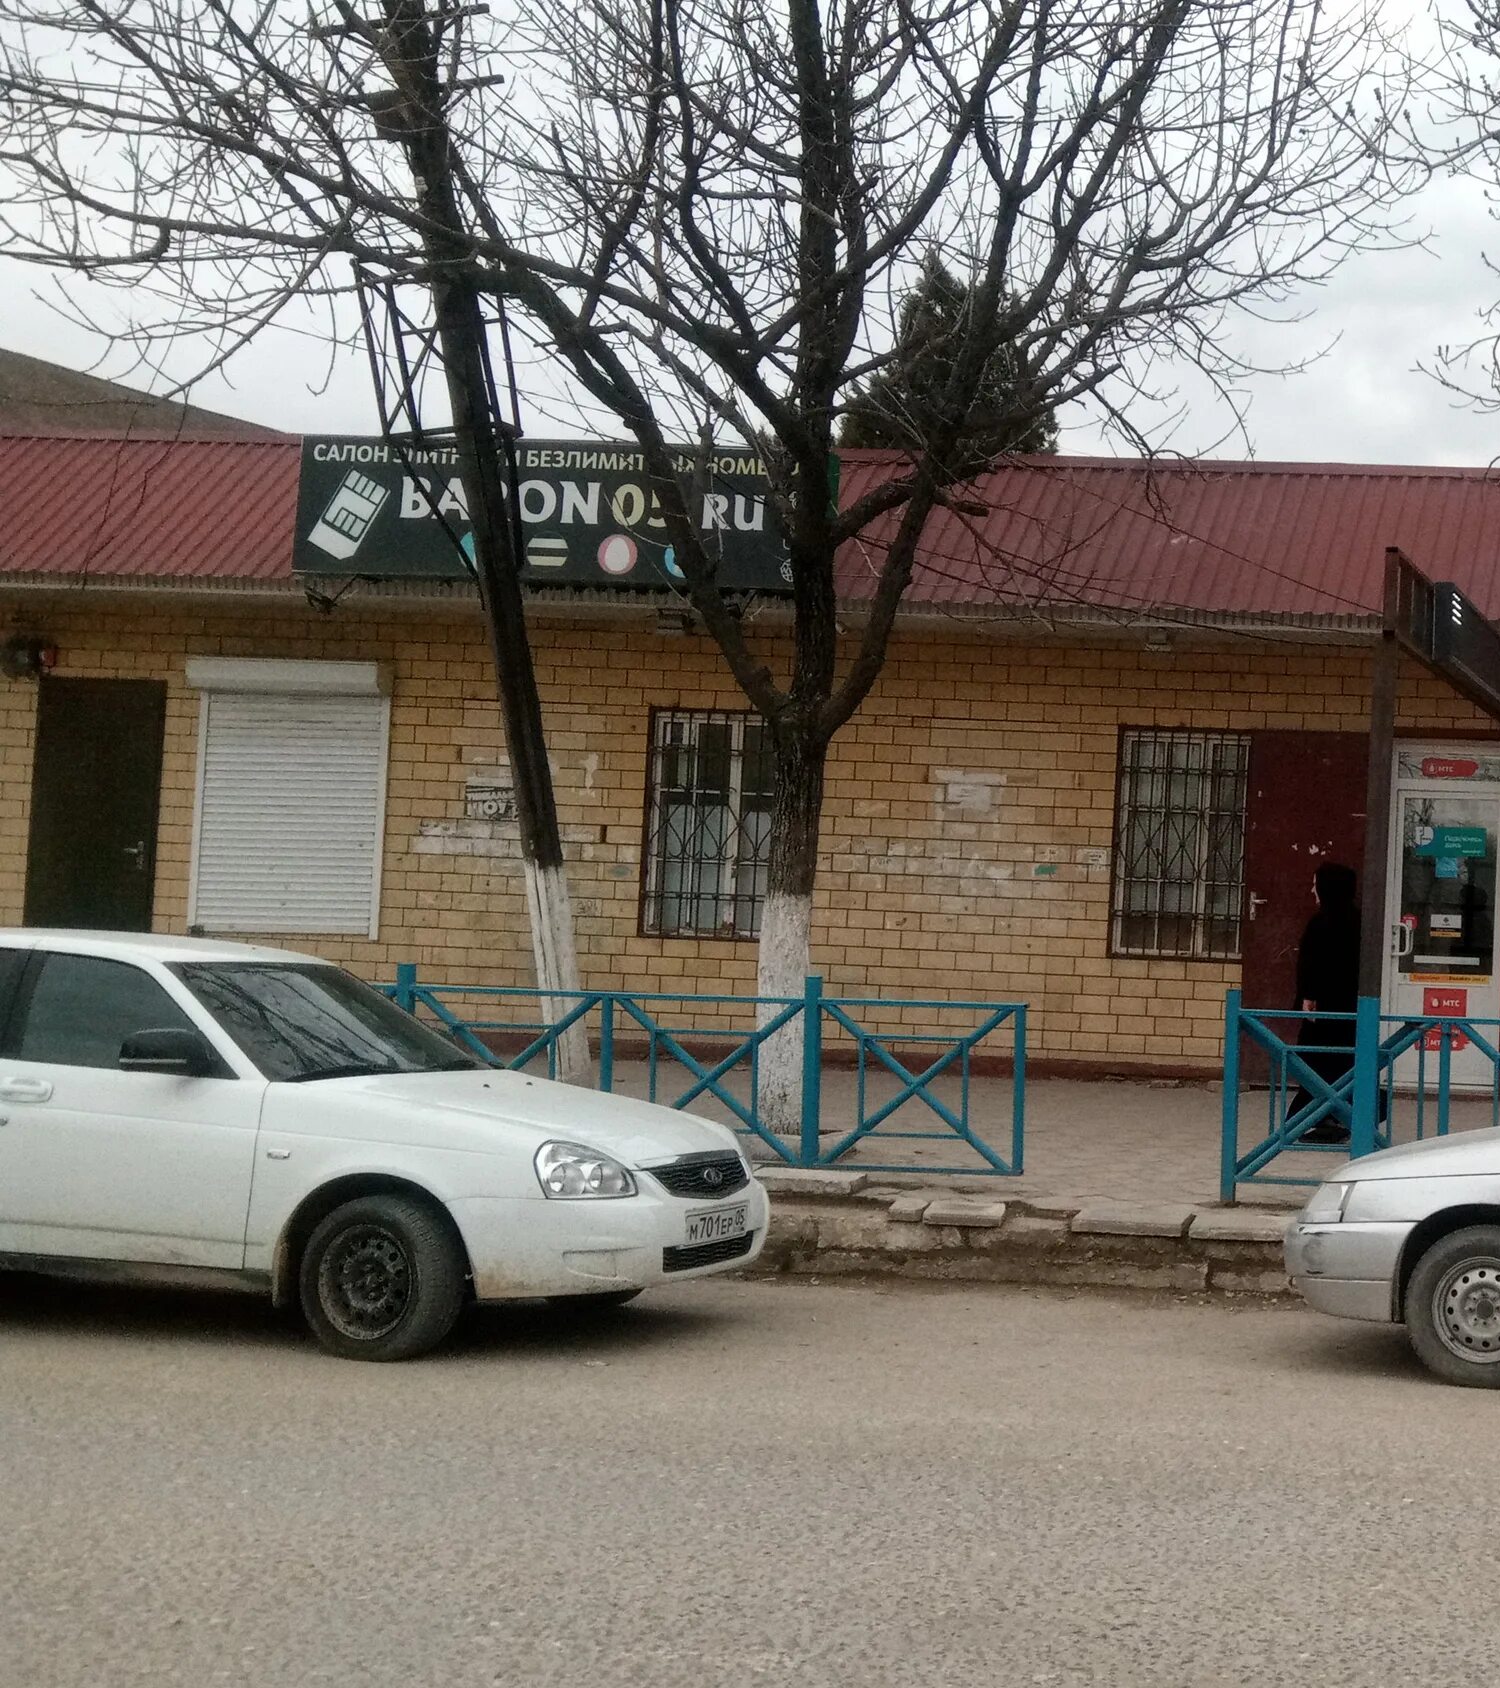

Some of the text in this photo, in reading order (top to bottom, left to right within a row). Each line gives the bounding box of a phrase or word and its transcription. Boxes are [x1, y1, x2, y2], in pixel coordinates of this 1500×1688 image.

[313, 443, 389, 463] САЛОН
[526, 449, 695, 473] БЕЗЛИМИТЫХ
[400, 475, 602, 525] BAON
[1442, 999, 1460, 1007] МТС
